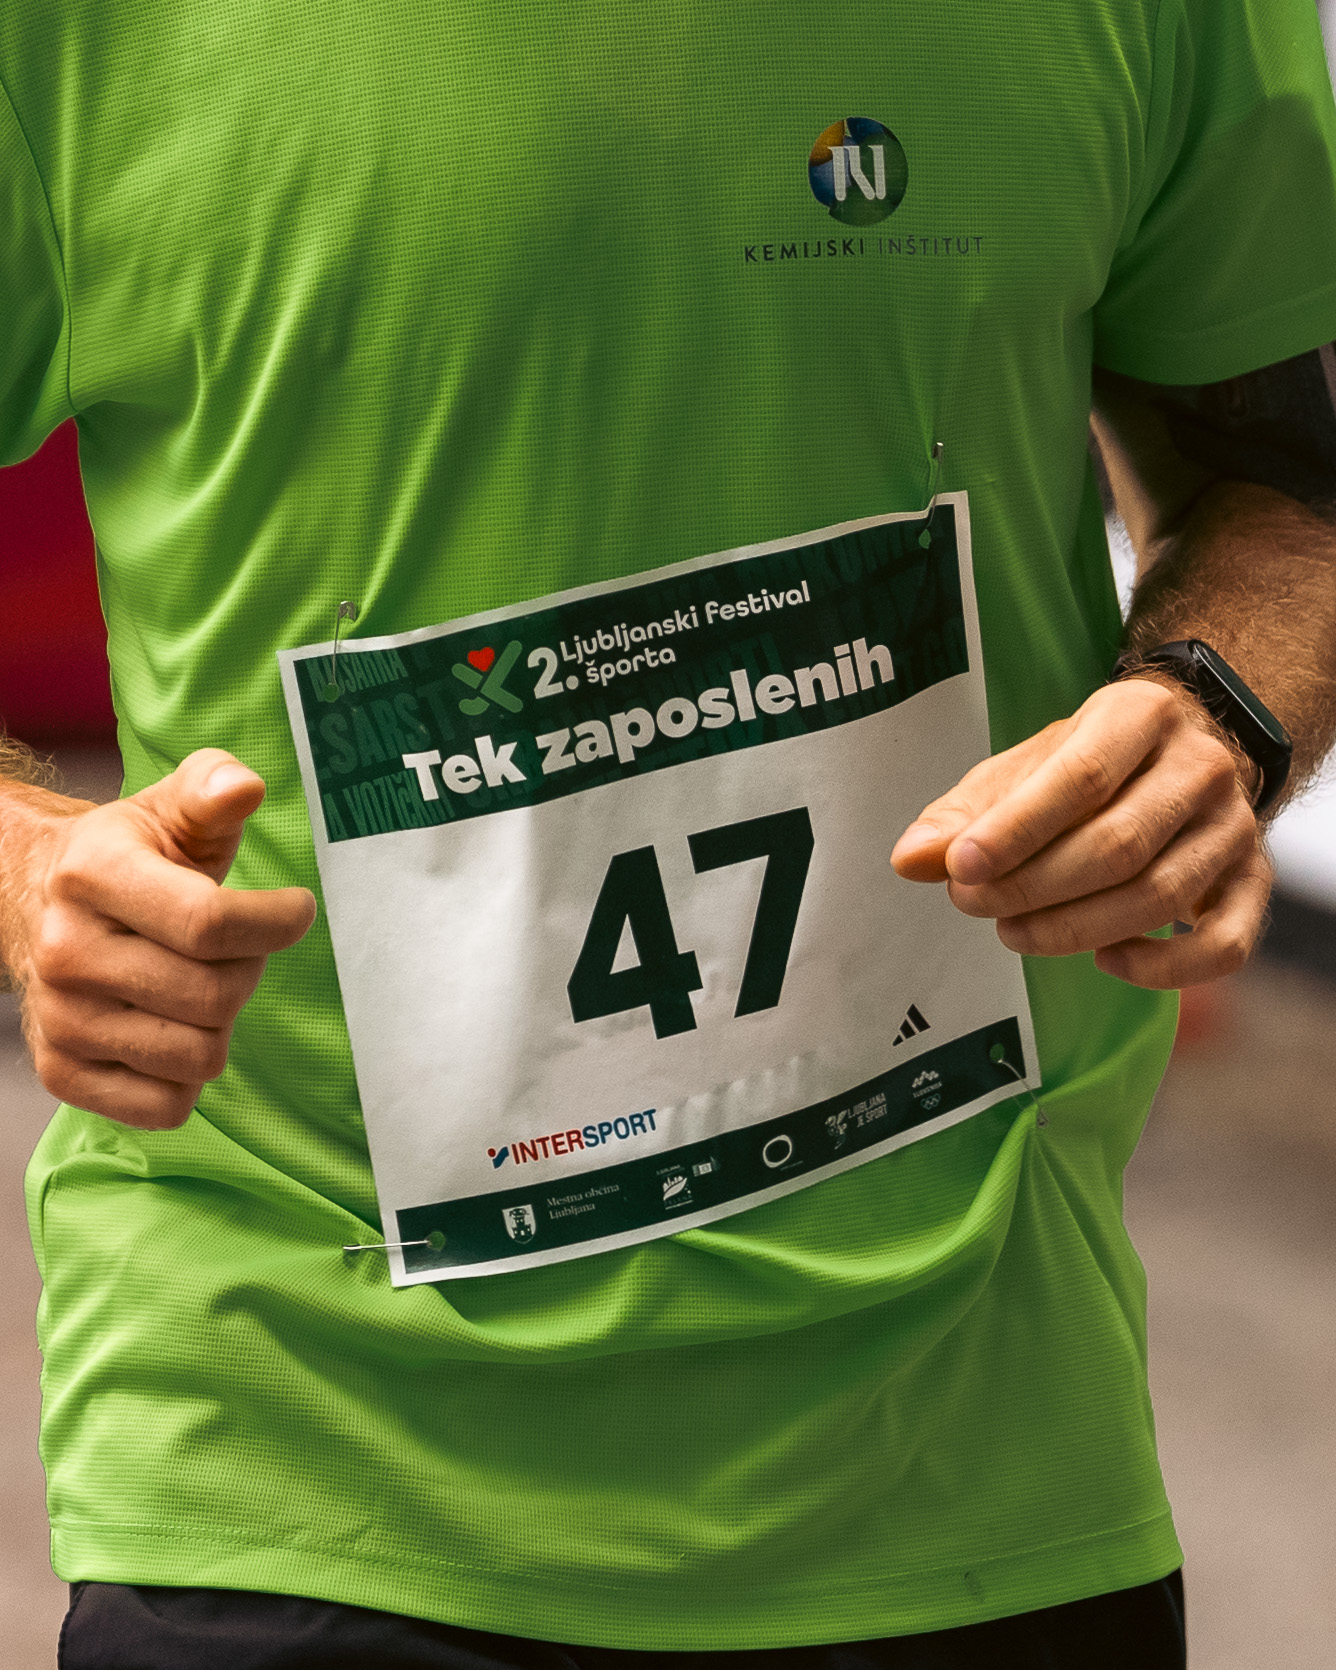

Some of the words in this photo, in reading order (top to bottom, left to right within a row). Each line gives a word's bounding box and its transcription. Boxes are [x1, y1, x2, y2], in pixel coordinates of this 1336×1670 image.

[744, 238, 865, 262] KEMIJSKI
[879, 234, 983, 256] INŠTITUT
[527, 646, 579, 699] 2.
[560, 605, 699, 663] Ljubljanski
[705, 580, 811, 624] festival
[586, 646, 676, 686] športa
[402, 734, 528, 801] Tek
[535, 637, 895, 774] zaposlenih
[567, 806, 815, 1040] 47
[511, 1108, 657, 1165] INTERSPORT
[546, 1192, 583, 1208] Mestna
[548, 1203, 596, 1220] Ljubljana
